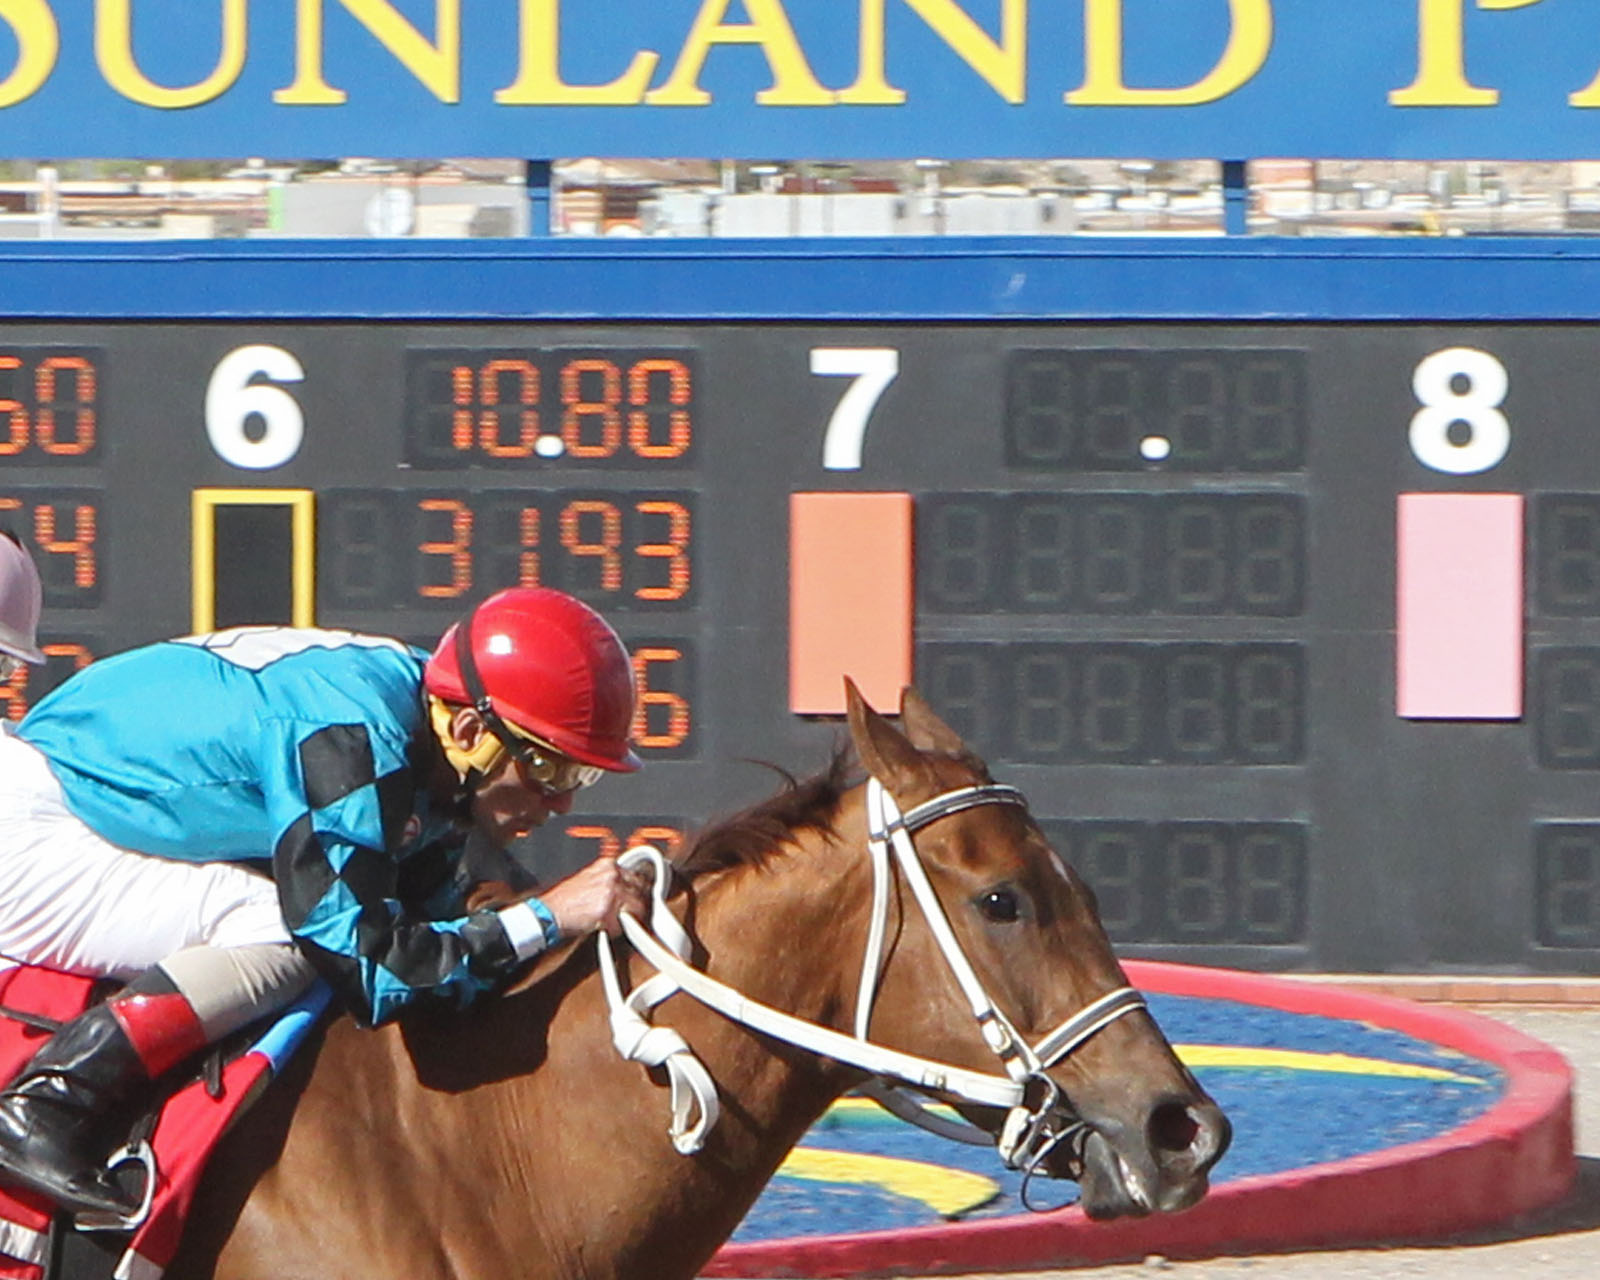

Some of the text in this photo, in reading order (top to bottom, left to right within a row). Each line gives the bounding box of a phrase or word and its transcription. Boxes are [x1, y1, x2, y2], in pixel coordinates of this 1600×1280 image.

[204, 344, 305, 469] 6
[451, 359, 691, 459] 10.80
[809, 347, 899, 470] 7
[1408, 347, 1511, 474] 8
[418, 499, 691, 599] 3193
